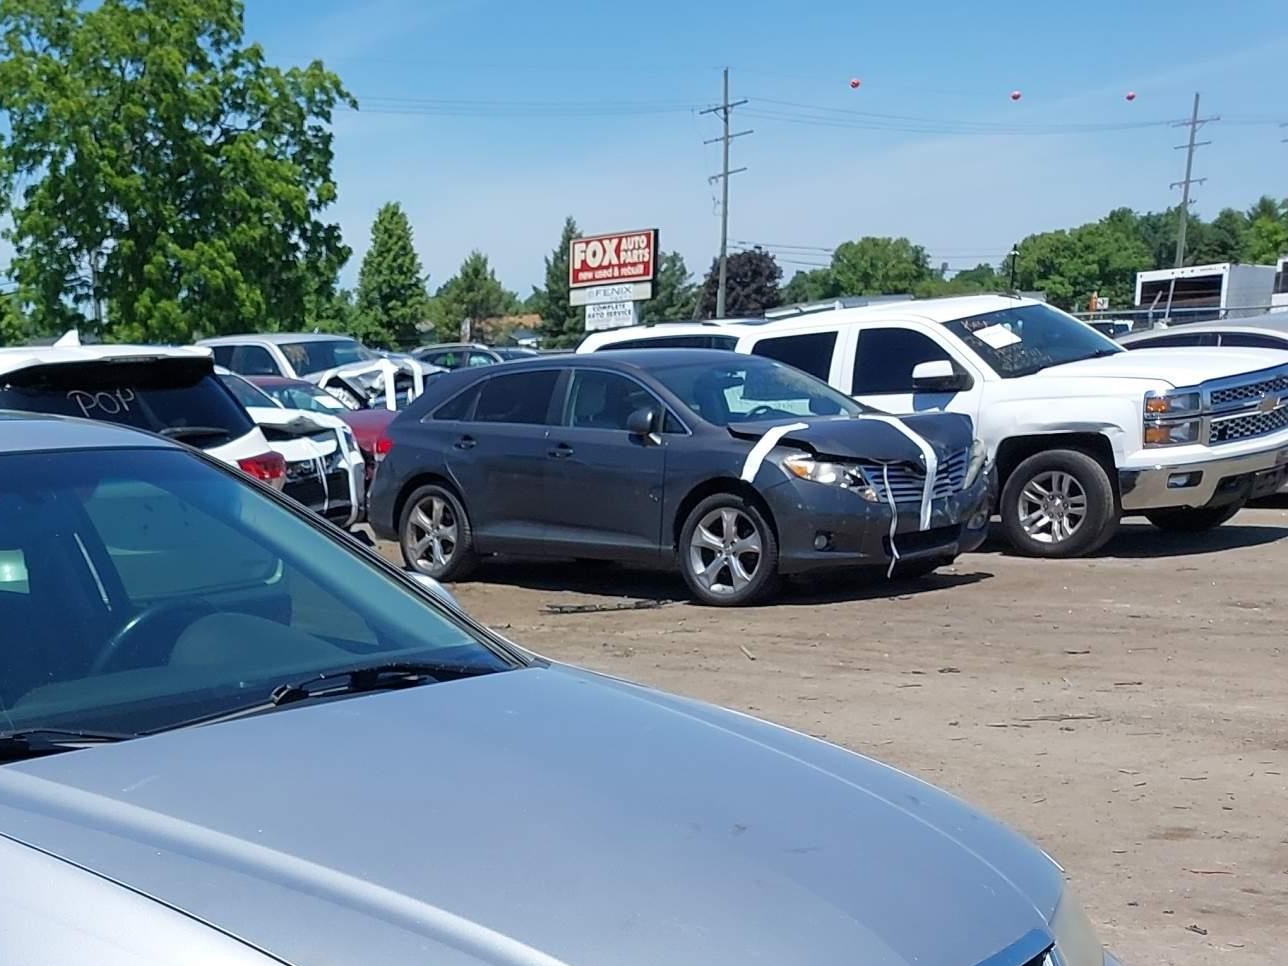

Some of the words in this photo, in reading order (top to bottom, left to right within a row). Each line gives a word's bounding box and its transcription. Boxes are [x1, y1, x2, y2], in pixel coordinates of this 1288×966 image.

[620, 235, 647, 249] AUTO
[574, 238, 619, 269] FOX
[620, 248, 649, 264] PARTS
[594, 267, 612, 279] used
